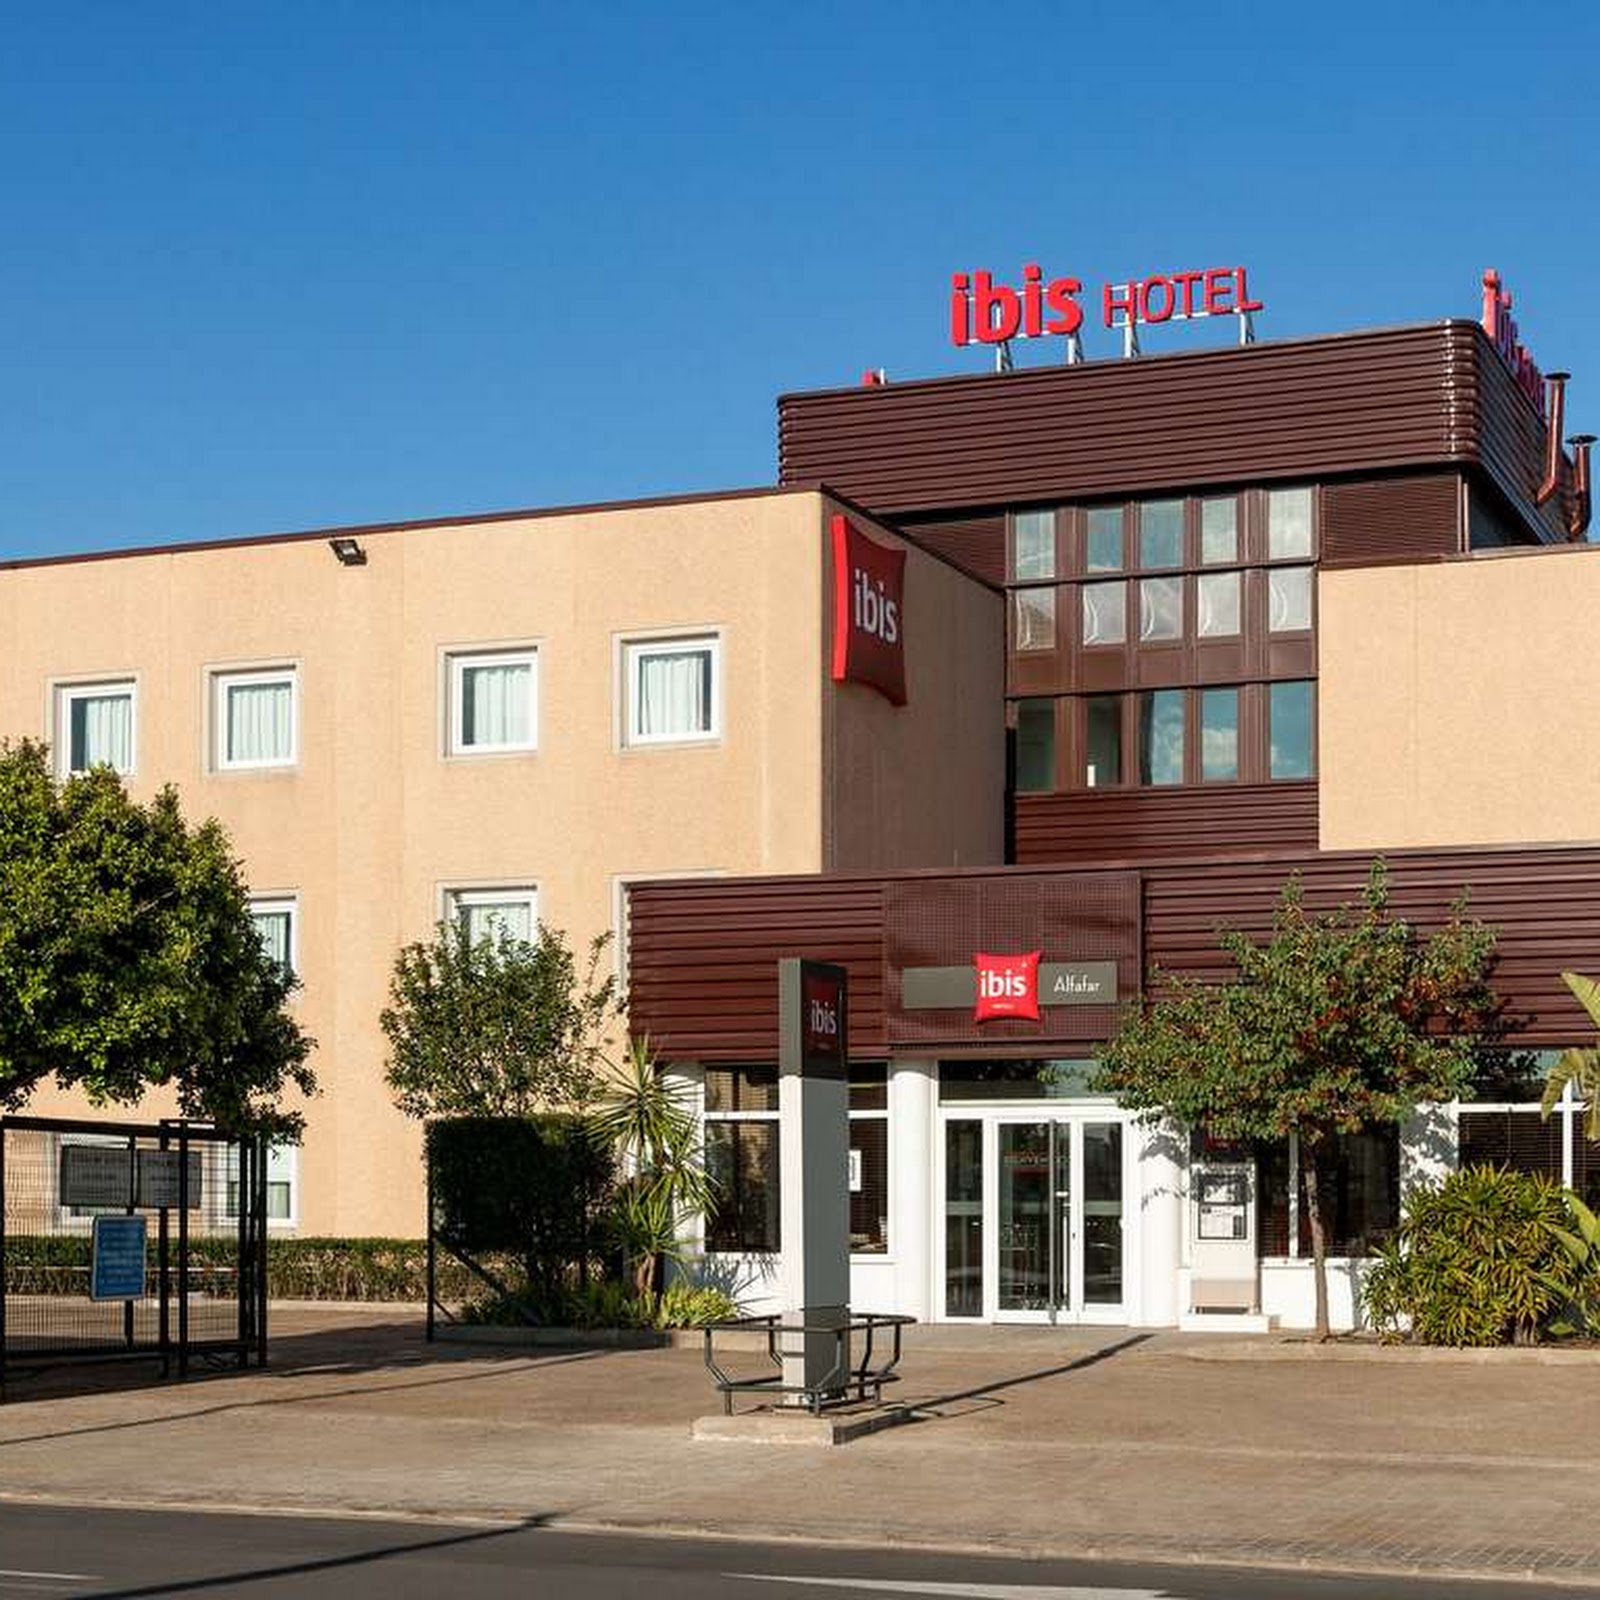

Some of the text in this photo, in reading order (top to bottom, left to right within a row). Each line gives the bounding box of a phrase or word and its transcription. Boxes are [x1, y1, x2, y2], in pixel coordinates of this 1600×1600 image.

[951, 264, 1264, 346] ibis HOTEL
[855, 568, 898, 644] ibis
[980, 969, 1027, 998] ibis
[1053, 974, 1101, 993] Alfafar
[811, 999, 837, 1034] ibis
